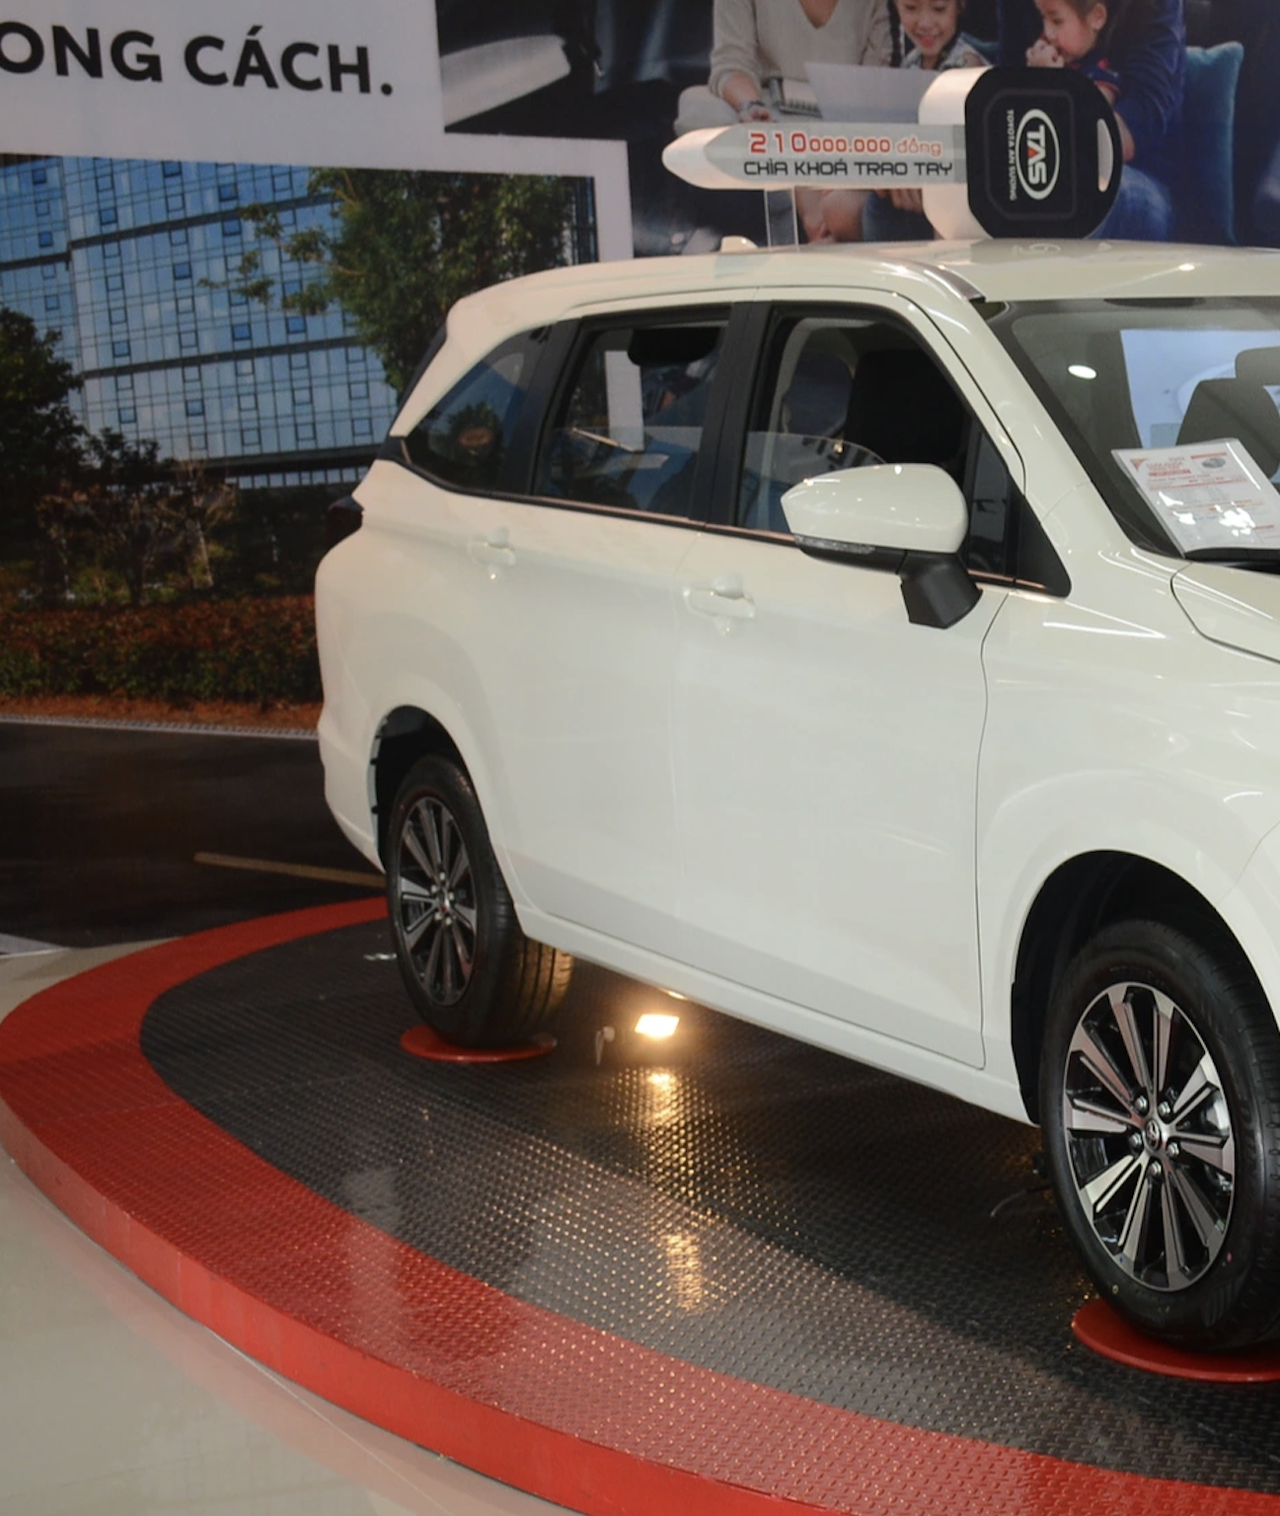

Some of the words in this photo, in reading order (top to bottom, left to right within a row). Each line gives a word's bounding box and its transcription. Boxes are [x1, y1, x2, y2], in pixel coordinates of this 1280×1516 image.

[0, 21, 163, 82] ONG
[184, 25, 394, 96] CÁCH.
[1006, 109, 1015, 148] TOYOTA
[744, 158, 788, 176] CHÌA
[794, 158, 848, 176] KHOÁ
[854, 162, 908, 176] TRAO
[914, 162, 953, 176] TAY
[1008, 148, 1016, 164] AN
[1026, 124, 1047, 185] TAS
